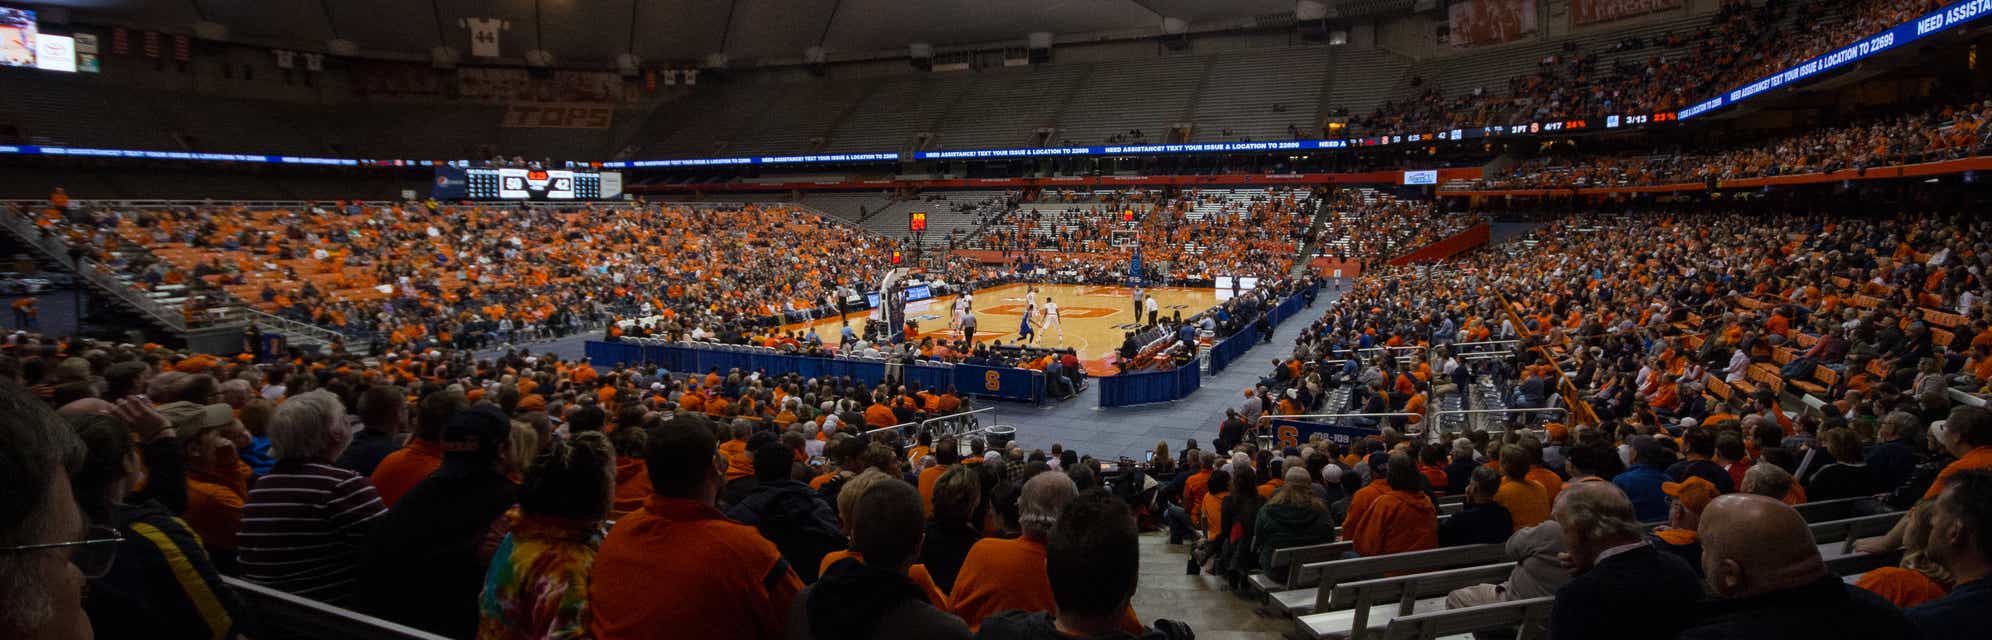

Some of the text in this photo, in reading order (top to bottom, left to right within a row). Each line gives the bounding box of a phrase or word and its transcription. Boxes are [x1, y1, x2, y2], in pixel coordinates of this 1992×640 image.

[1917, 0, 1992, 35] NEED ASSISTA
[475, 31, 494, 43] 44
[1731, 89, 1742, 101] NEED
[1771, 73, 1784, 88] TEXT
[1784, 68, 1799, 83] YOUR
[1799, 61, 1818, 77] ISSUE
[1818, 59, 1824, 71] &
[1824, 45, 1858, 69] LOCATION
[1859, 42, 1870, 56] TO
[1870, 32, 1895, 53] 22699
[510, 106, 610, 127] TOPS
[1544, 122, 1563, 131] 4/17
[1626, 115, 1648, 124] 3/13
[555, 178, 570, 190] 42
[985, 370, 1000, 391] S
[1278, 425, 1299, 449] S
